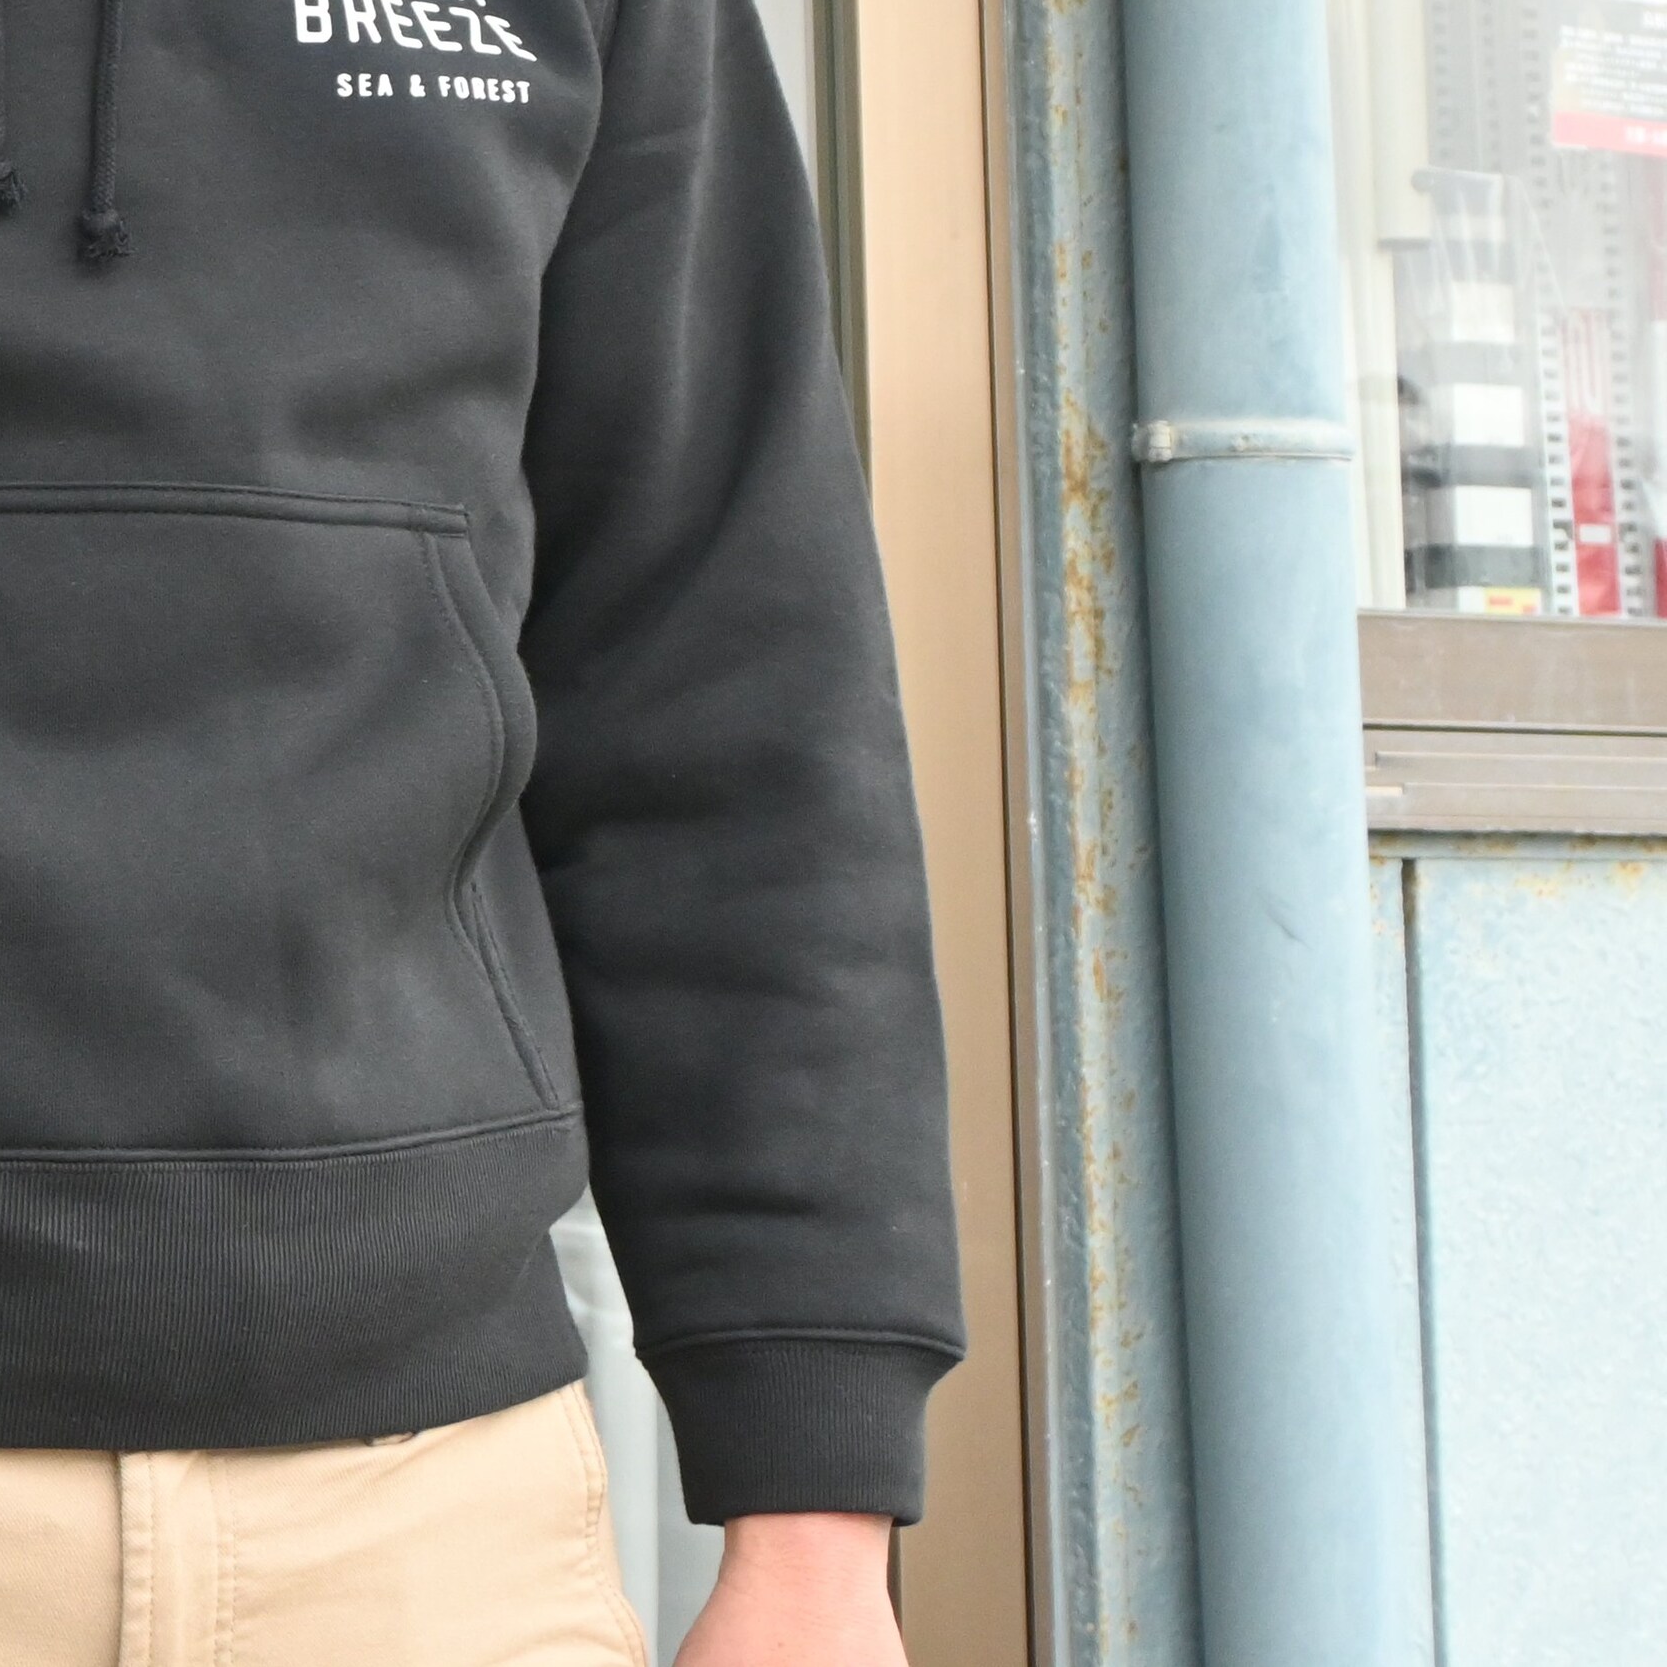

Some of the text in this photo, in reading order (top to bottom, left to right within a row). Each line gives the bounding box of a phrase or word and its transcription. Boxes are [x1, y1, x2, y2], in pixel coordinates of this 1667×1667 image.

[337, 73, 531, 104] SEA & FOREST
